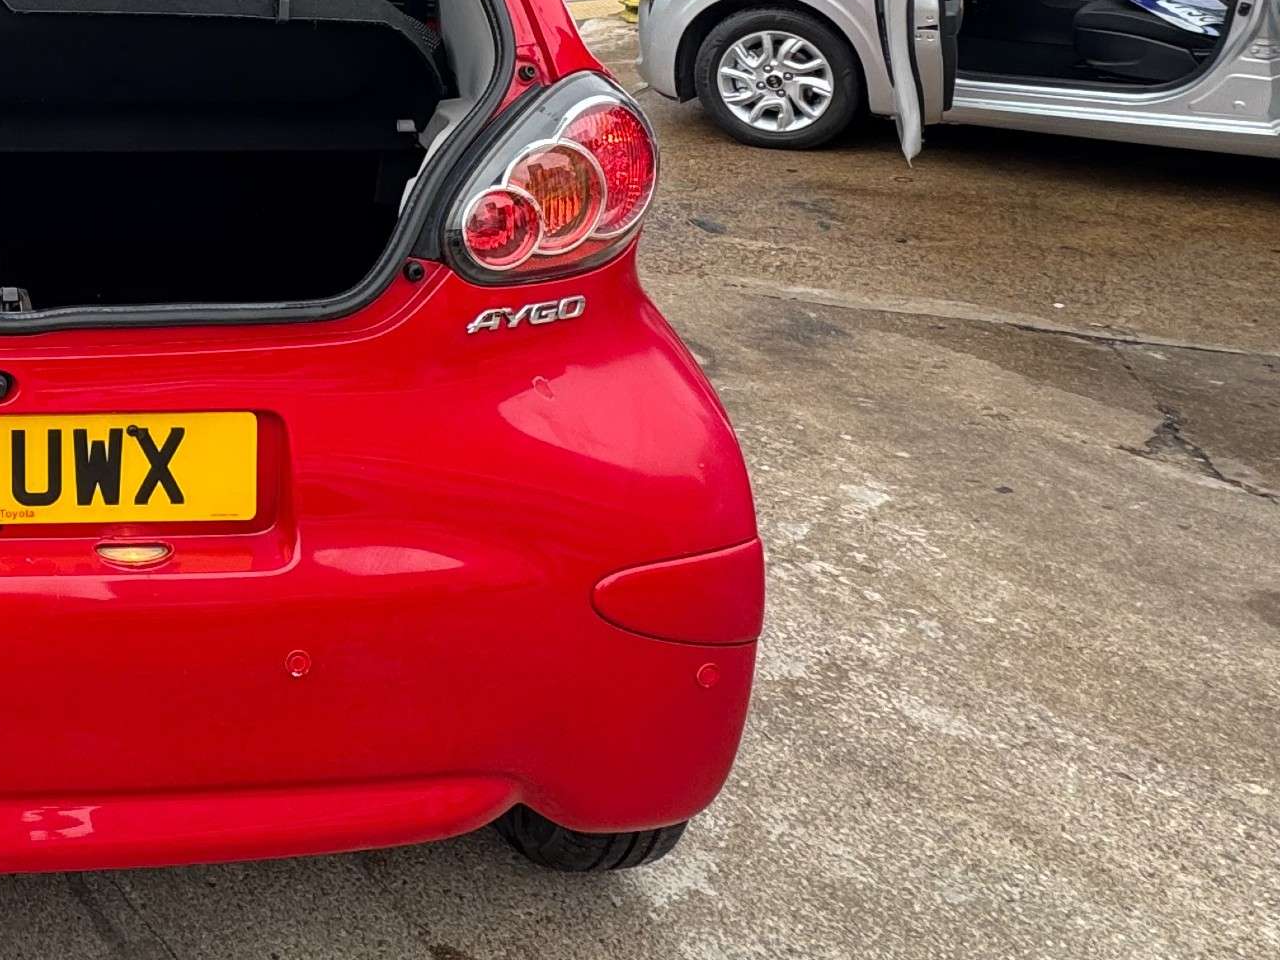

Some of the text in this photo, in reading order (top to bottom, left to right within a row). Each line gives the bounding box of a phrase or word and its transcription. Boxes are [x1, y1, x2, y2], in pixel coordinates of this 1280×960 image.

[466, 294, 586, 334] AYGO
[11, 426, 185, 507] UWX
[0, 508, 35, 520] Toyota
